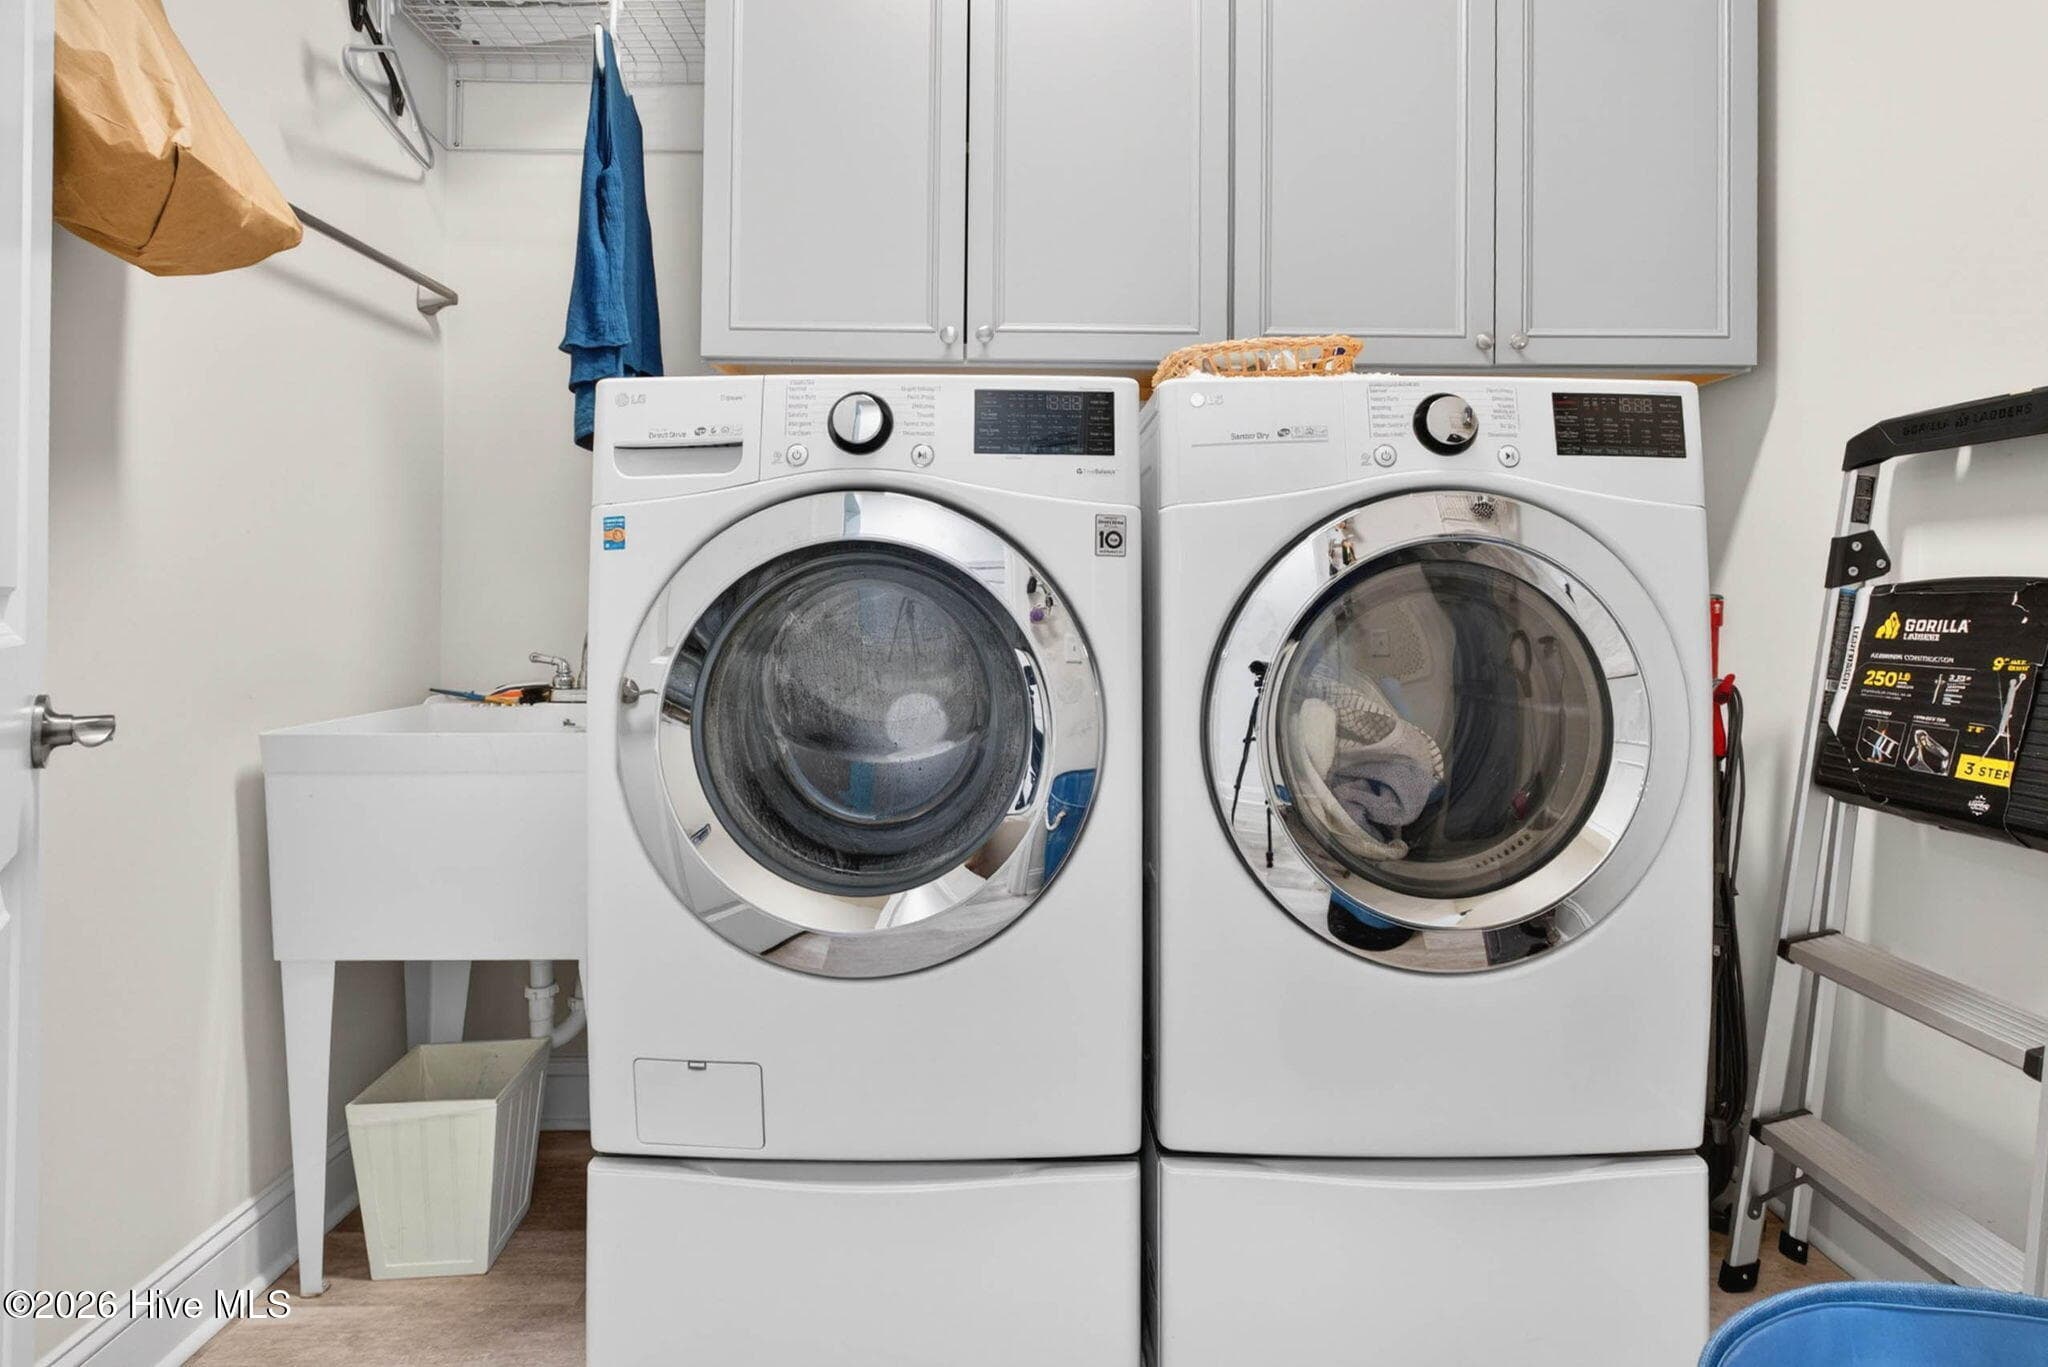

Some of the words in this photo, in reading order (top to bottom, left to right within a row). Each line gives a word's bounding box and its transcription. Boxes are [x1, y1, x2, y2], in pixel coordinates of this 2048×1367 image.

[630, 394, 647, 405] LG
[1974, 402, 2033, 423] LADDERS
[1230, 432, 1254, 441] Sensor
[1256, 431, 1270, 440] Dry
[1099, 530, 1123, 549] 10
[1904, 618, 1969, 634] GORILLA
[1863, 670, 1897, 688] 250
[1964, 762, 1976, 776] 3
[1978, 766, 2011, 781] STEP
